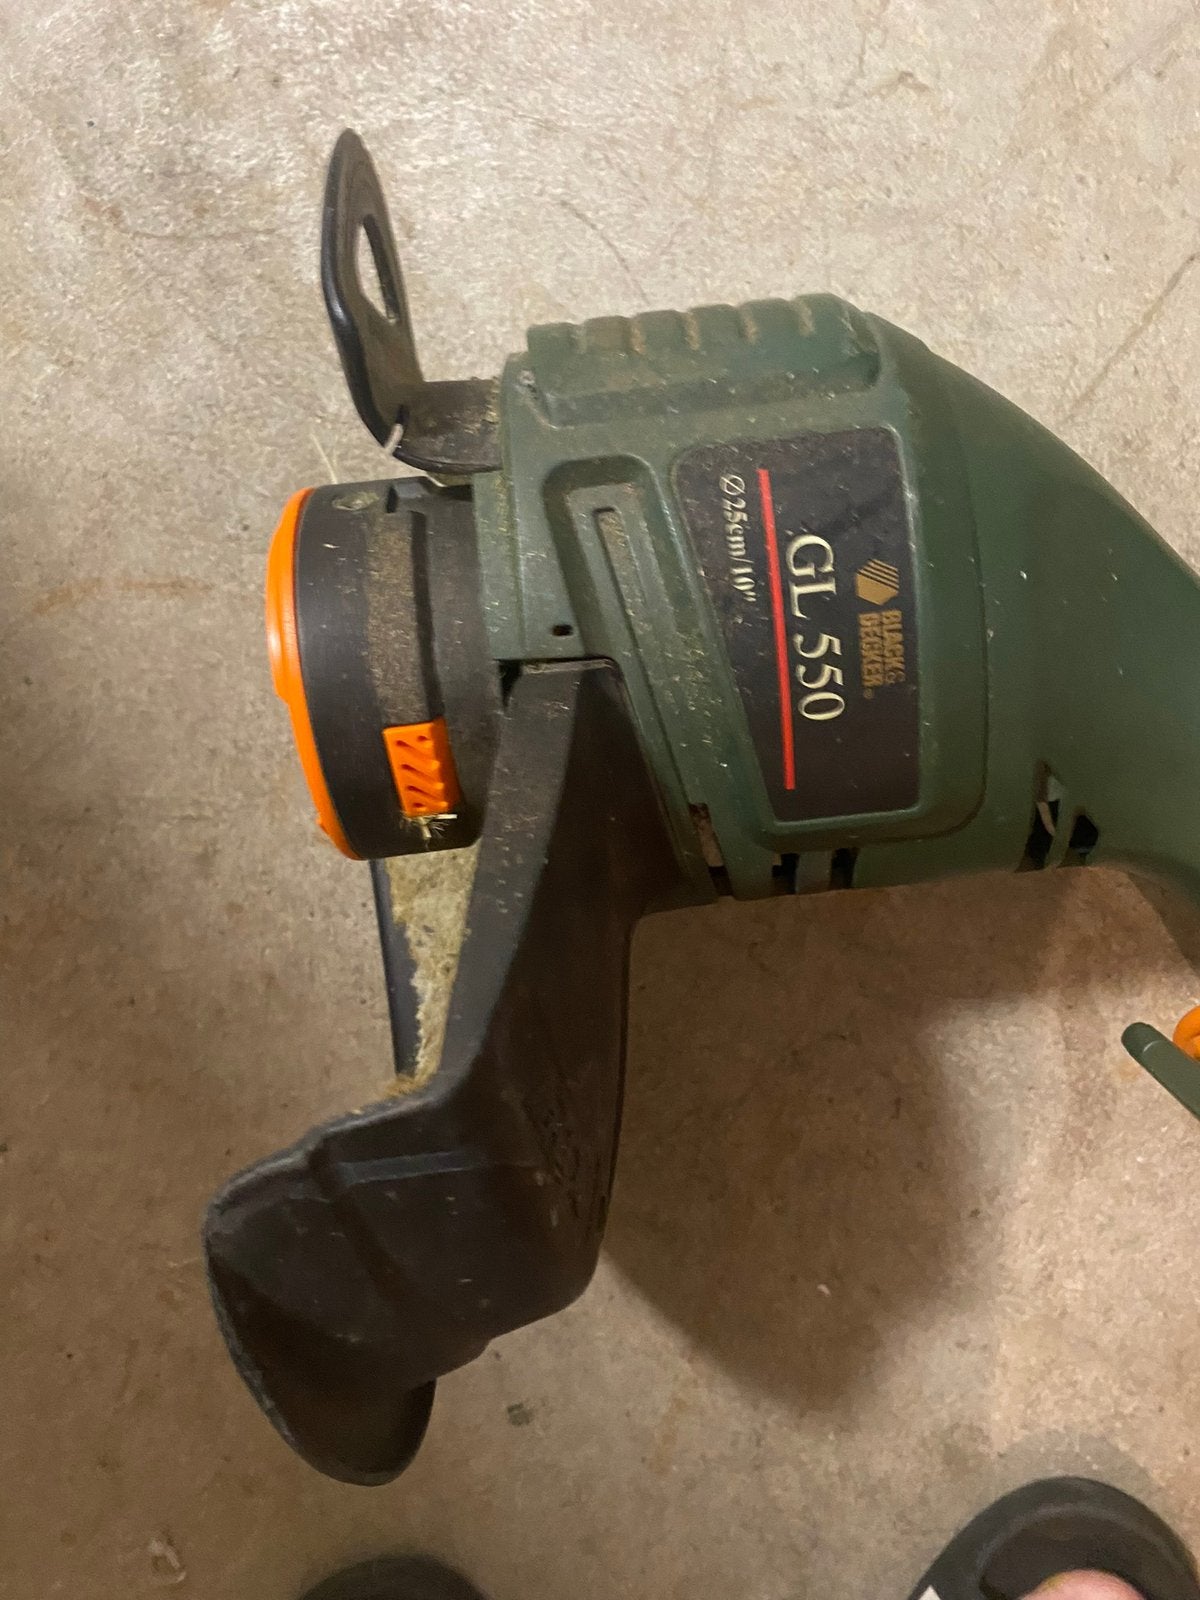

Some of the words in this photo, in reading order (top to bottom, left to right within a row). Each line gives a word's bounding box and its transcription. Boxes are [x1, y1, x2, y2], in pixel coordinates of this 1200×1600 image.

[785, 534, 837, 619] GL
[793, 632, 845, 721] 550
[859, 612, 883, 687] DECKER
